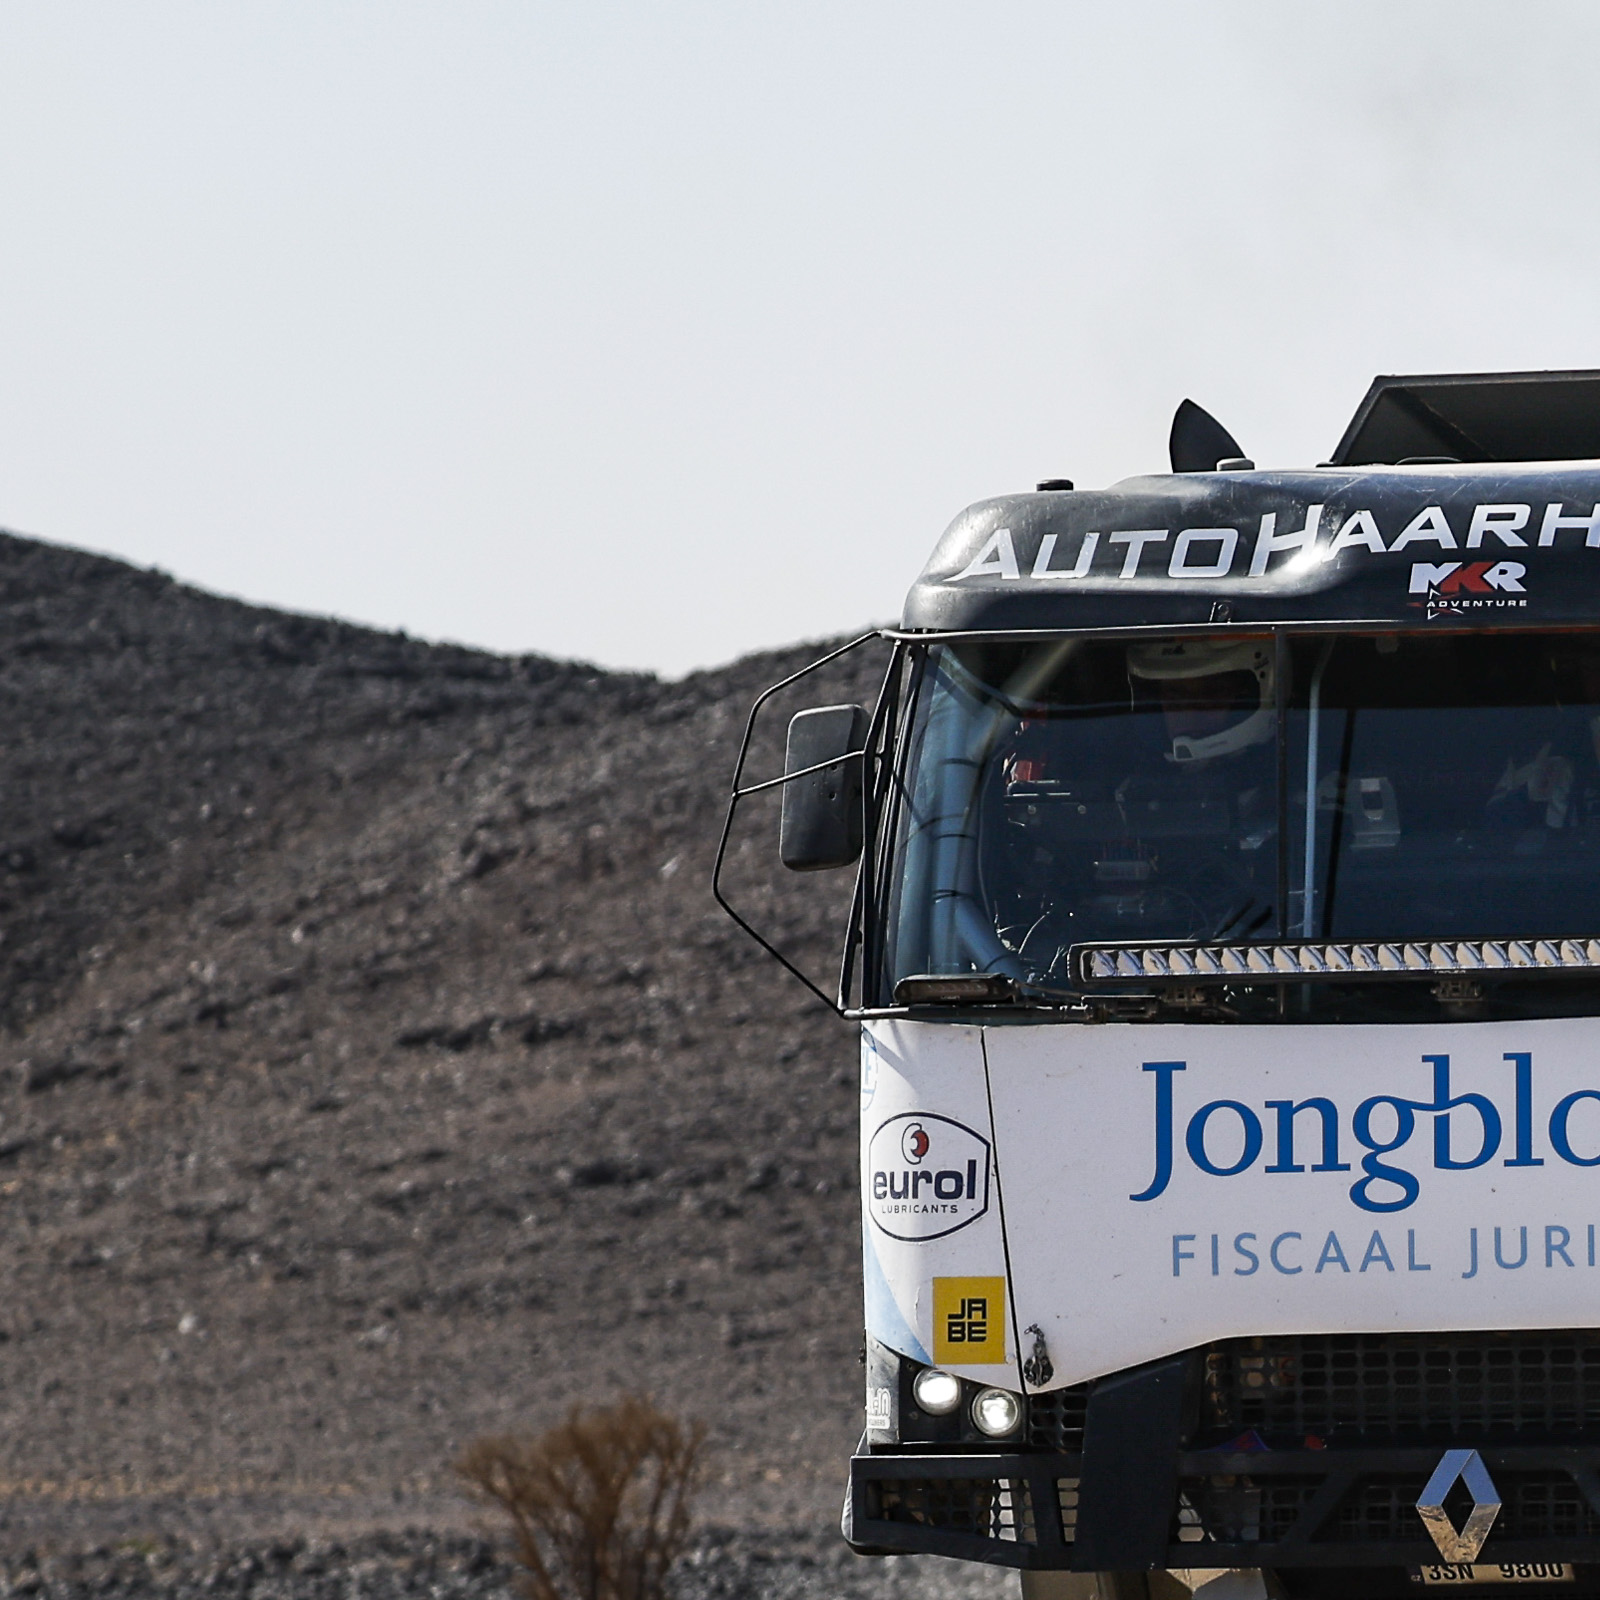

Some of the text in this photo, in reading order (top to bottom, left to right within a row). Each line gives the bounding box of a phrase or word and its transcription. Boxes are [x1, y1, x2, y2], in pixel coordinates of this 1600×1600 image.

[1409, 561, 1527, 593] MKR
[1427, 600, 1527, 608] ADVENTURE
[873, 1160, 976, 1201] eurol
[881, 1204, 959, 1214] LUBRICANTS
[1172, 1228, 1432, 1277] FISCAAL
